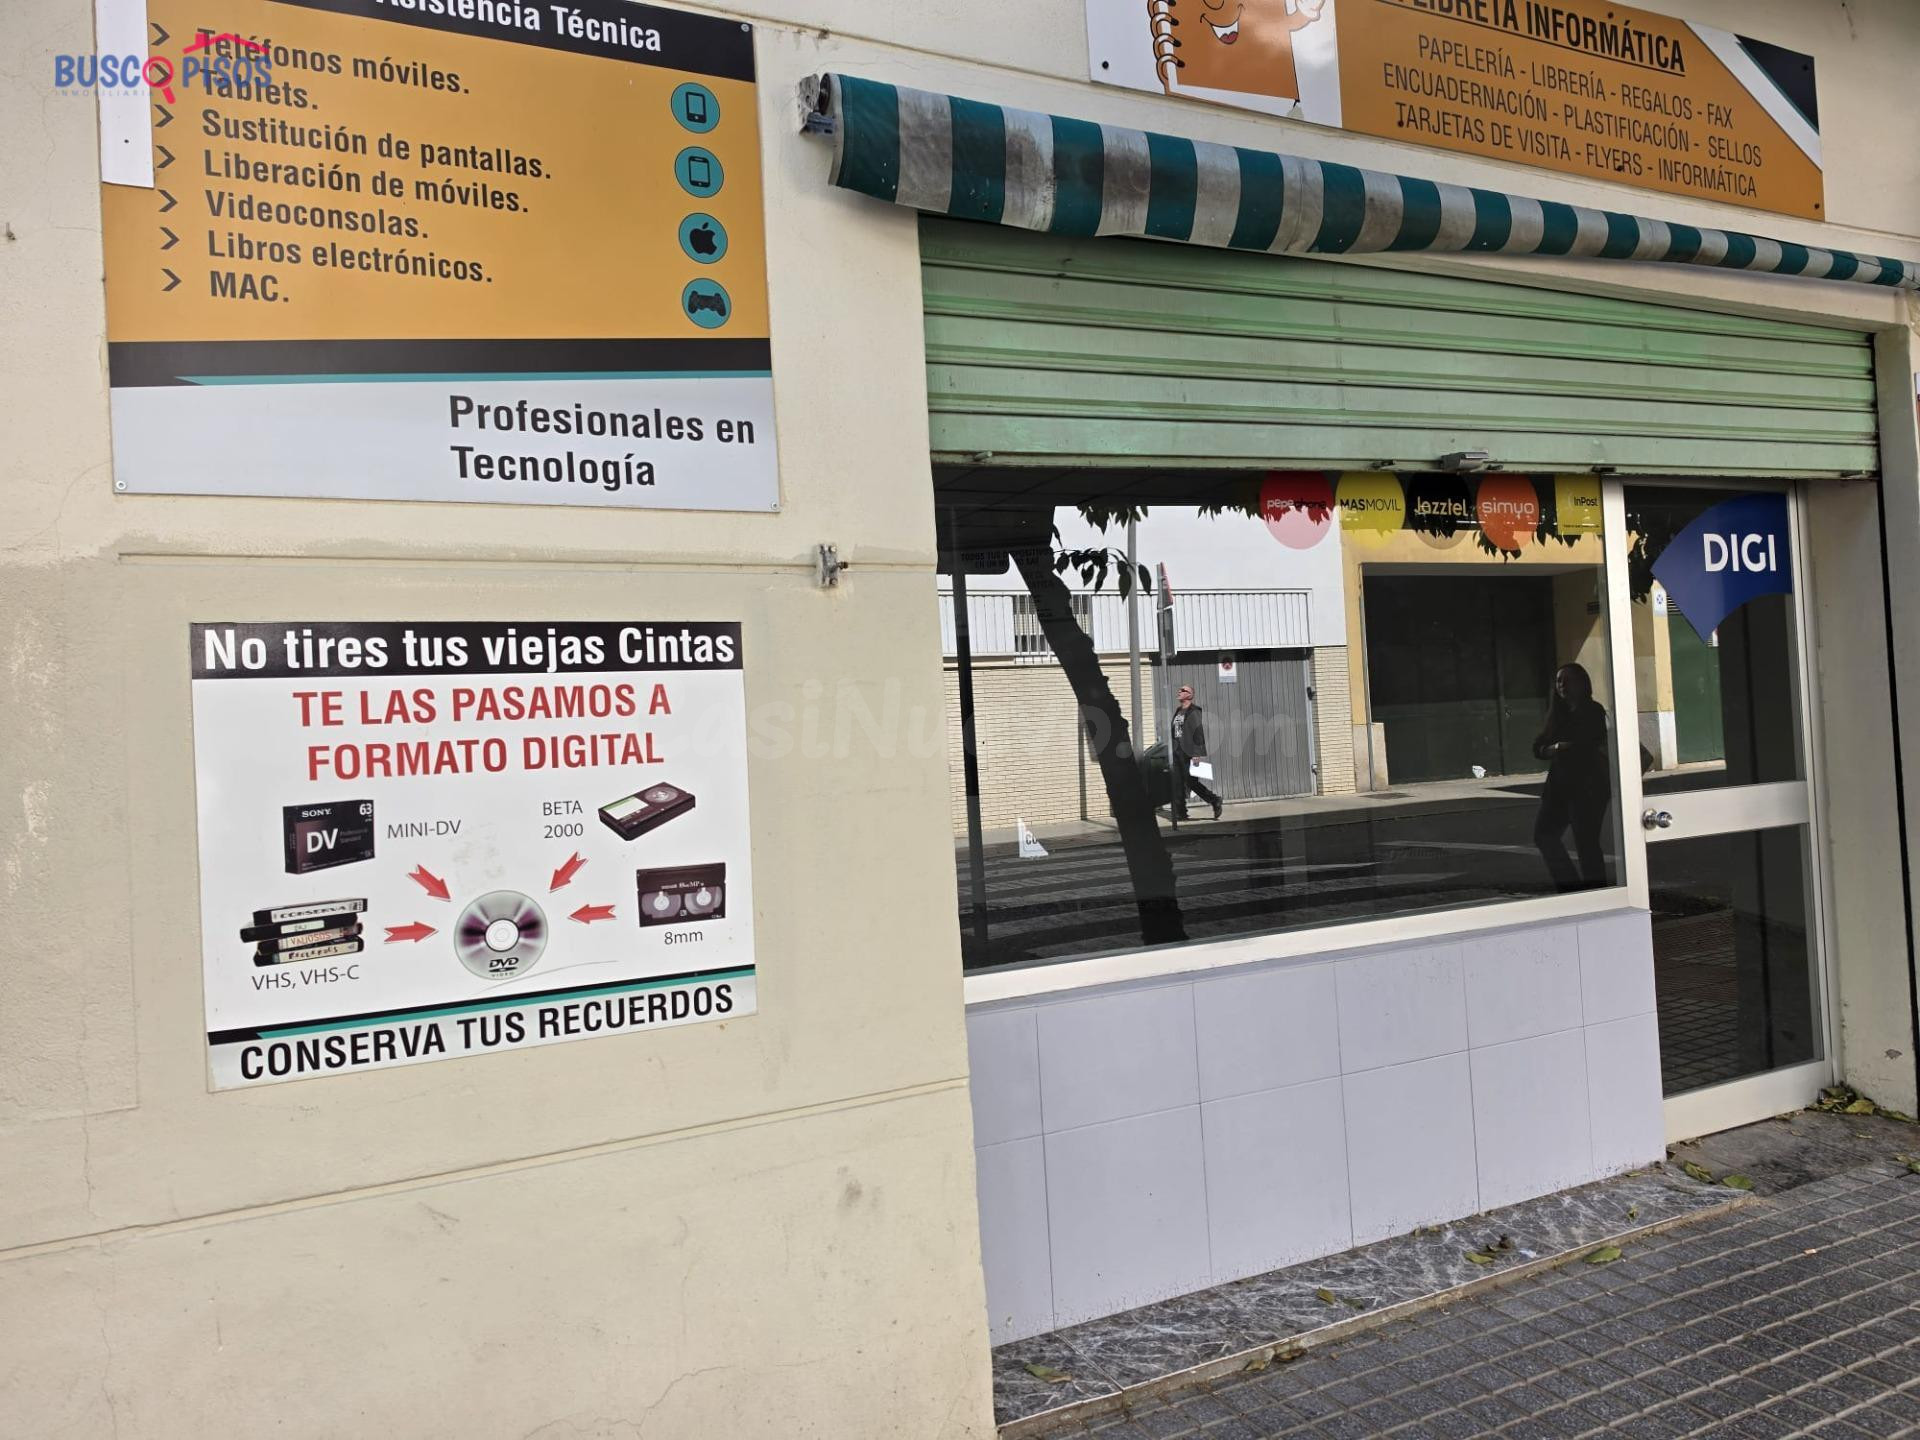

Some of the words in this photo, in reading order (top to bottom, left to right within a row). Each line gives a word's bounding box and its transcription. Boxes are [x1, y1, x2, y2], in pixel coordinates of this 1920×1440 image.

[375, 0, 541, 31] stencia
[550, 5, 661, 51] Técnica
[1526, 1, 1685, 73] INFORMÁTICA
[197, 28, 342, 75] Teléfonos
[353, 57, 469, 94] móviles.
[1418, 34, 1515, 80] PAPELERÍA
[1532, 62, 1606, 101] LIBRERÍA
[1621, 84, 1693, 120] REGALOS
[1707, 103, 1733, 129] FAX
[199, 68, 318, 110] Tablets.
[1383, 62, 1547, 122] ENCUADERNACIÓN
[1564, 103, 1689, 152] PLASTIFICACIÓN
[1708, 135, 1762, 167] SELLOS
[202, 109, 367, 155] Sustitución
[377, 132, 410, 160] de
[421, 143, 551, 179] pantallas.
[1395, 102, 1485, 143] TARJETAS
[1491, 122, 1513, 149] DE
[1518, 127, 1571, 161] VISITA
[1587, 143, 1643, 176] FLYERS
[1658, 158, 1757, 198] INFORMÁTICA
[204, 149, 361, 193] Liberación
[371, 170, 404, 198] de
[415, 178, 528, 213] móviles.
[205, 190, 428, 239] Videoconsolas.
[208, 230, 301, 265] Libros
[312, 242, 493, 283] electrónicos.
[209, 270, 289, 303] MAC.
[449, 395, 704, 441] Profesionales
[716, 418, 755, 444] en
[450, 445, 655, 492] Tecnología
[1340, 498, 1401, 511] MASMOVIL
[1414, 496, 1468, 517] Jazztel
[1482, 497, 1535, 518] simyo
[1573, 496, 1599, 507] InPost
[1703, 533, 1777, 573] DIGI
[204, 629, 267, 670] No
[283, 628, 388, 669] tires
[402, 630, 469, 667] tus
[482, 628, 605, 673] viejas
[618, 627, 735, 665] Cintas
[292, 691, 344, 727] TE
[360, 688, 437, 725] LAS
[452, 684, 636, 721] PASAMOS
[648, 683, 672, 715] A
[308, 738, 508, 781] FORMATO
[523, 732, 665, 770] DIGITAL
[301, 808, 332, 818] SONY
[359, 803, 373, 816] 63
[387, 819, 461, 839] MINI-DV
[542, 800, 583, 816] BETA
[306, 828, 338, 853] DV
[543, 823, 584, 839] 2000
[664, 931, 703, 945] 8mm
[252, 972, 296, 990] VHS,
[300, 965, 360, 985] VHS-C
[489, 957, 519, 968] DVD
[240, 1022, 445, 1080] CONSERVA
[457, 1011, 526, 1050] TUS
[539, 983, 734, 1038] RECUERDOS
